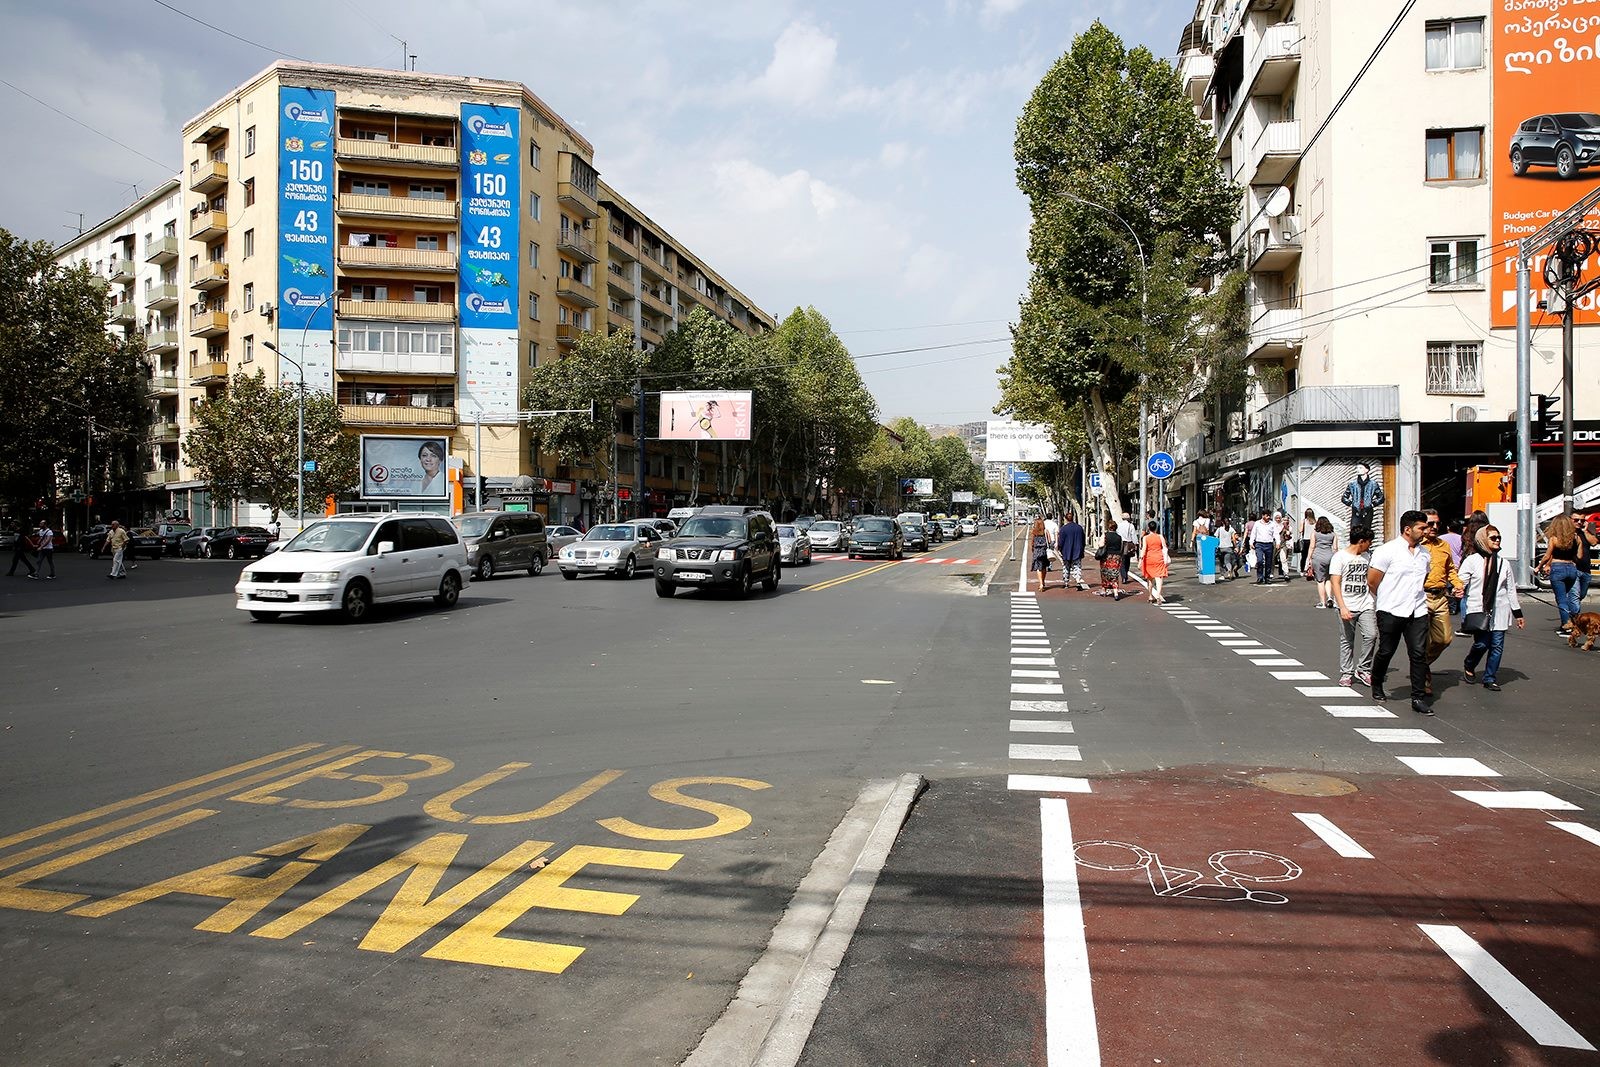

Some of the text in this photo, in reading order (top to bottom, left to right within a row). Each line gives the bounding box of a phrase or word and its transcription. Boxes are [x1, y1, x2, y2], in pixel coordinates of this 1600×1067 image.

[1504, 33, 1600, 75] ლიზი
[290, 159, 323, 181] 150
[285, 183, 327, 194] კულტურული
[473, 172, 506, 196] 150
[469, 197, 511, 209] კულტურული
[294, 210, 318, 232] 43
[1503, 211, 1534, 220] Budget
[1535, 210, 1550, 218] Car
[477, 225, 501, 248] 43
[1503, 224, 1537, 233] Phone
[735, 401, 746, 437] SKIN
[1018, 433, 1033, 441] only
[375, 467, 384, 479] 2
[226, 750, 773, 841] BUS
[0, 809, 684, 974] LANE
